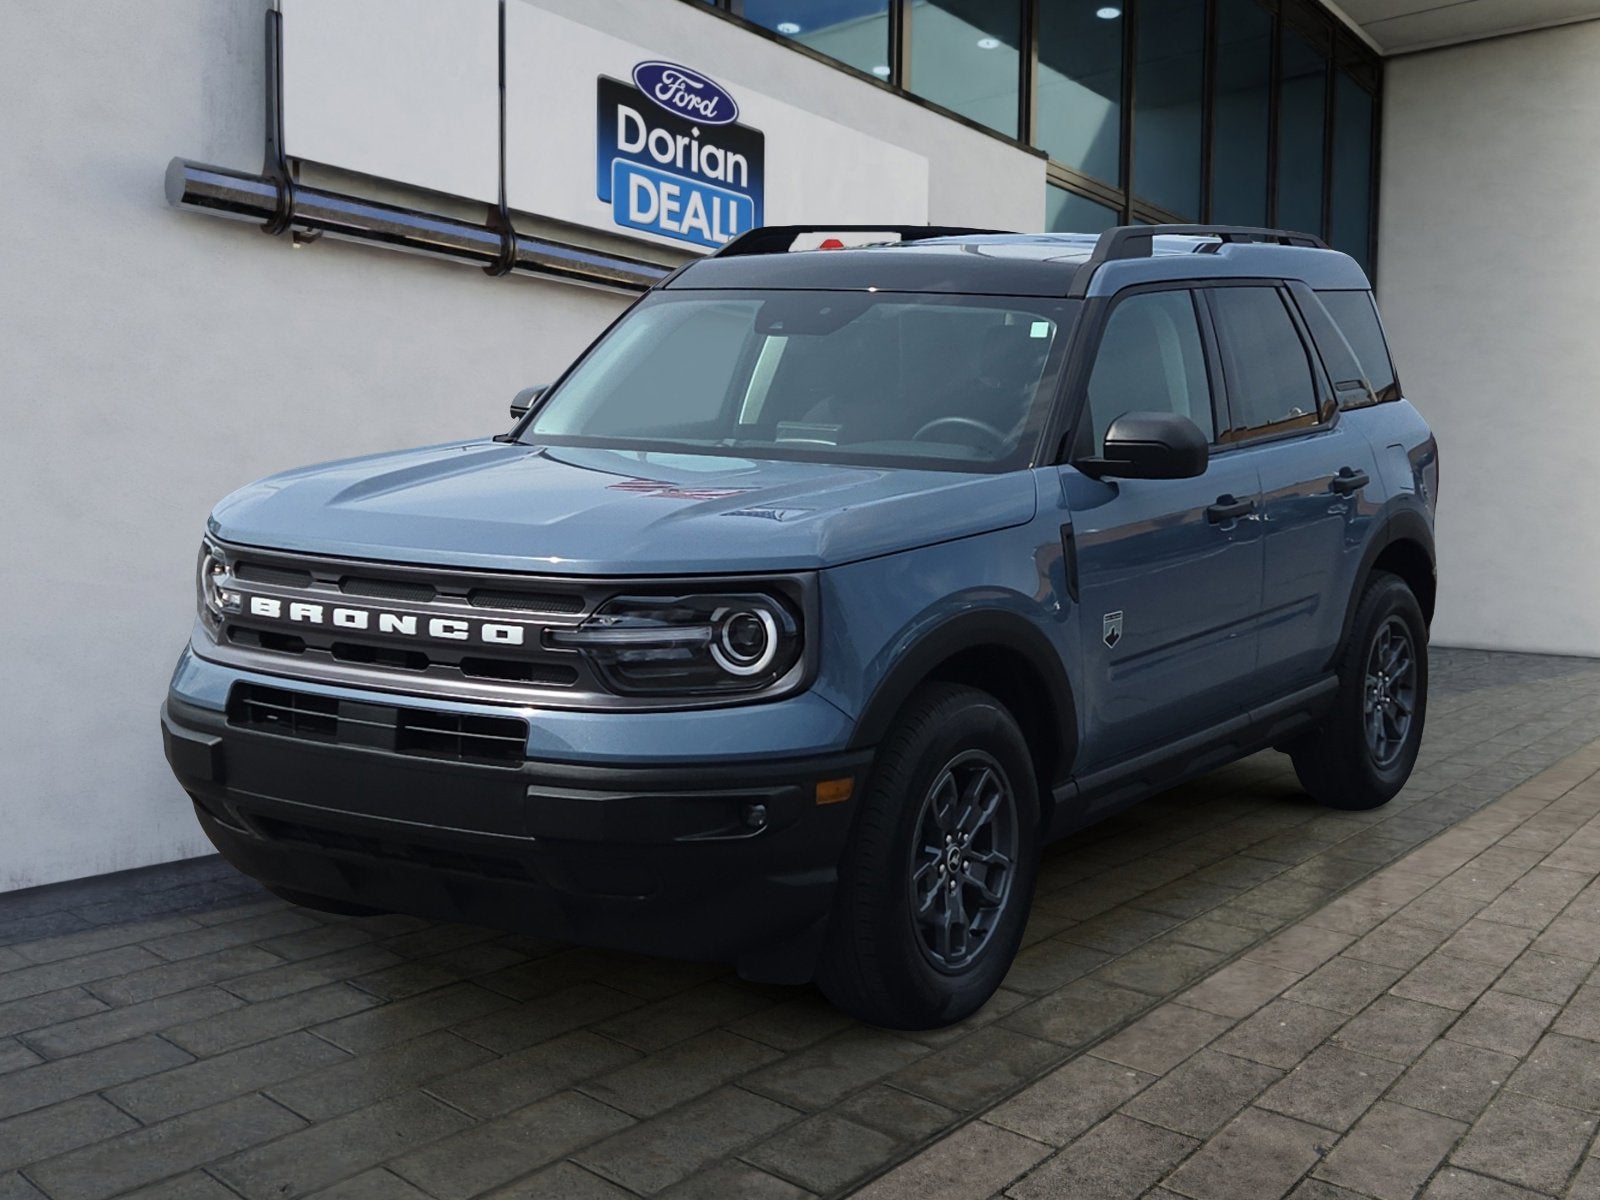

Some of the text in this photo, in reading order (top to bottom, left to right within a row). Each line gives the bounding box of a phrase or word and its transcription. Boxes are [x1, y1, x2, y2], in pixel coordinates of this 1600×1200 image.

[655, 70, 718, 118] Ford
[617, 103, 748, 188] Dorian
[250, 596, 525, 645] BRONCO
